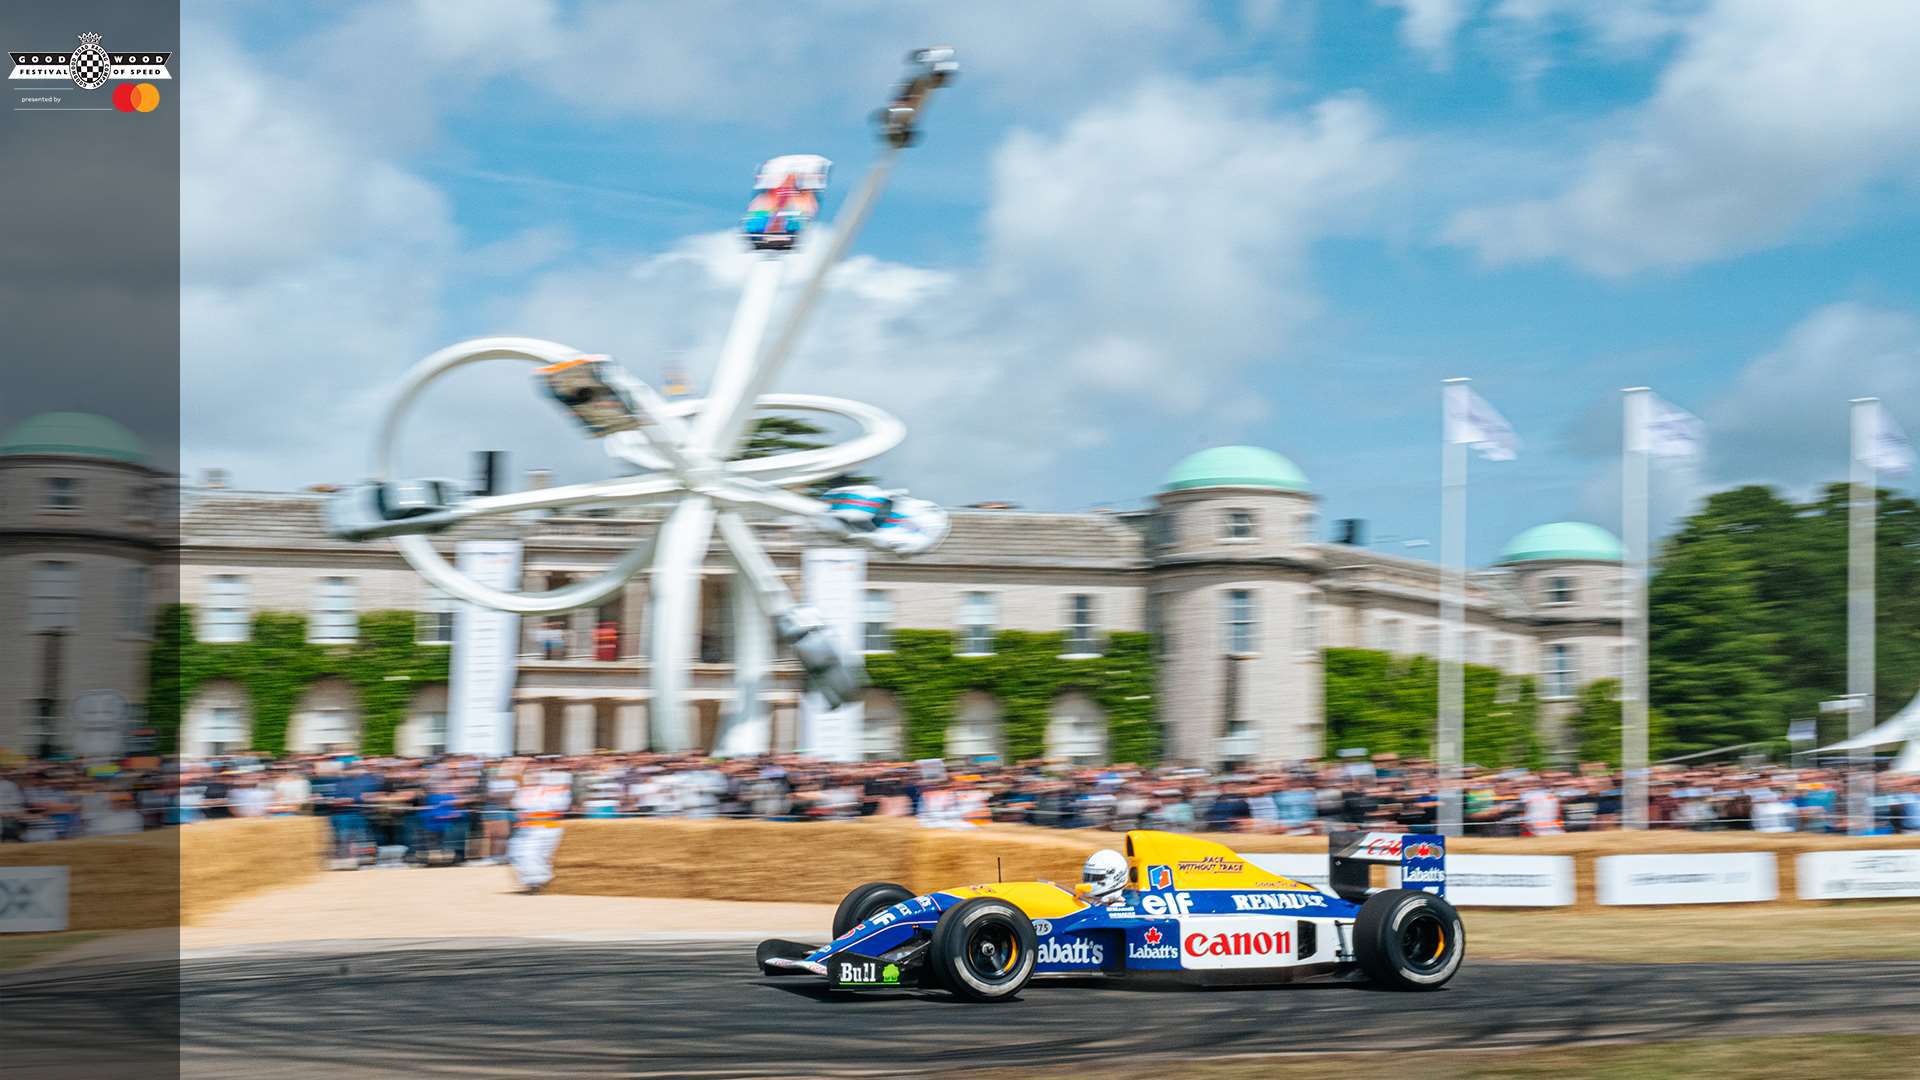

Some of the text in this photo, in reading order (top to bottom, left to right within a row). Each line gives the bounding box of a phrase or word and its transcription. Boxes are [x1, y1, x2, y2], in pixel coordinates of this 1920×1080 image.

[1220, 863, 1243, 871] TRACE
[1402, 865, 1445, 882] Labatt's
[1141, 892, 1194, 916] elf
[1231, 893, 1328, 911] RENAULT
[1037, 936, 1104, 964] abatt's
[1128, 943, 1179, 960] Labatt's
[1184, 930, 1290, 957] Canon
[839, 962, 877, 983] Bull
